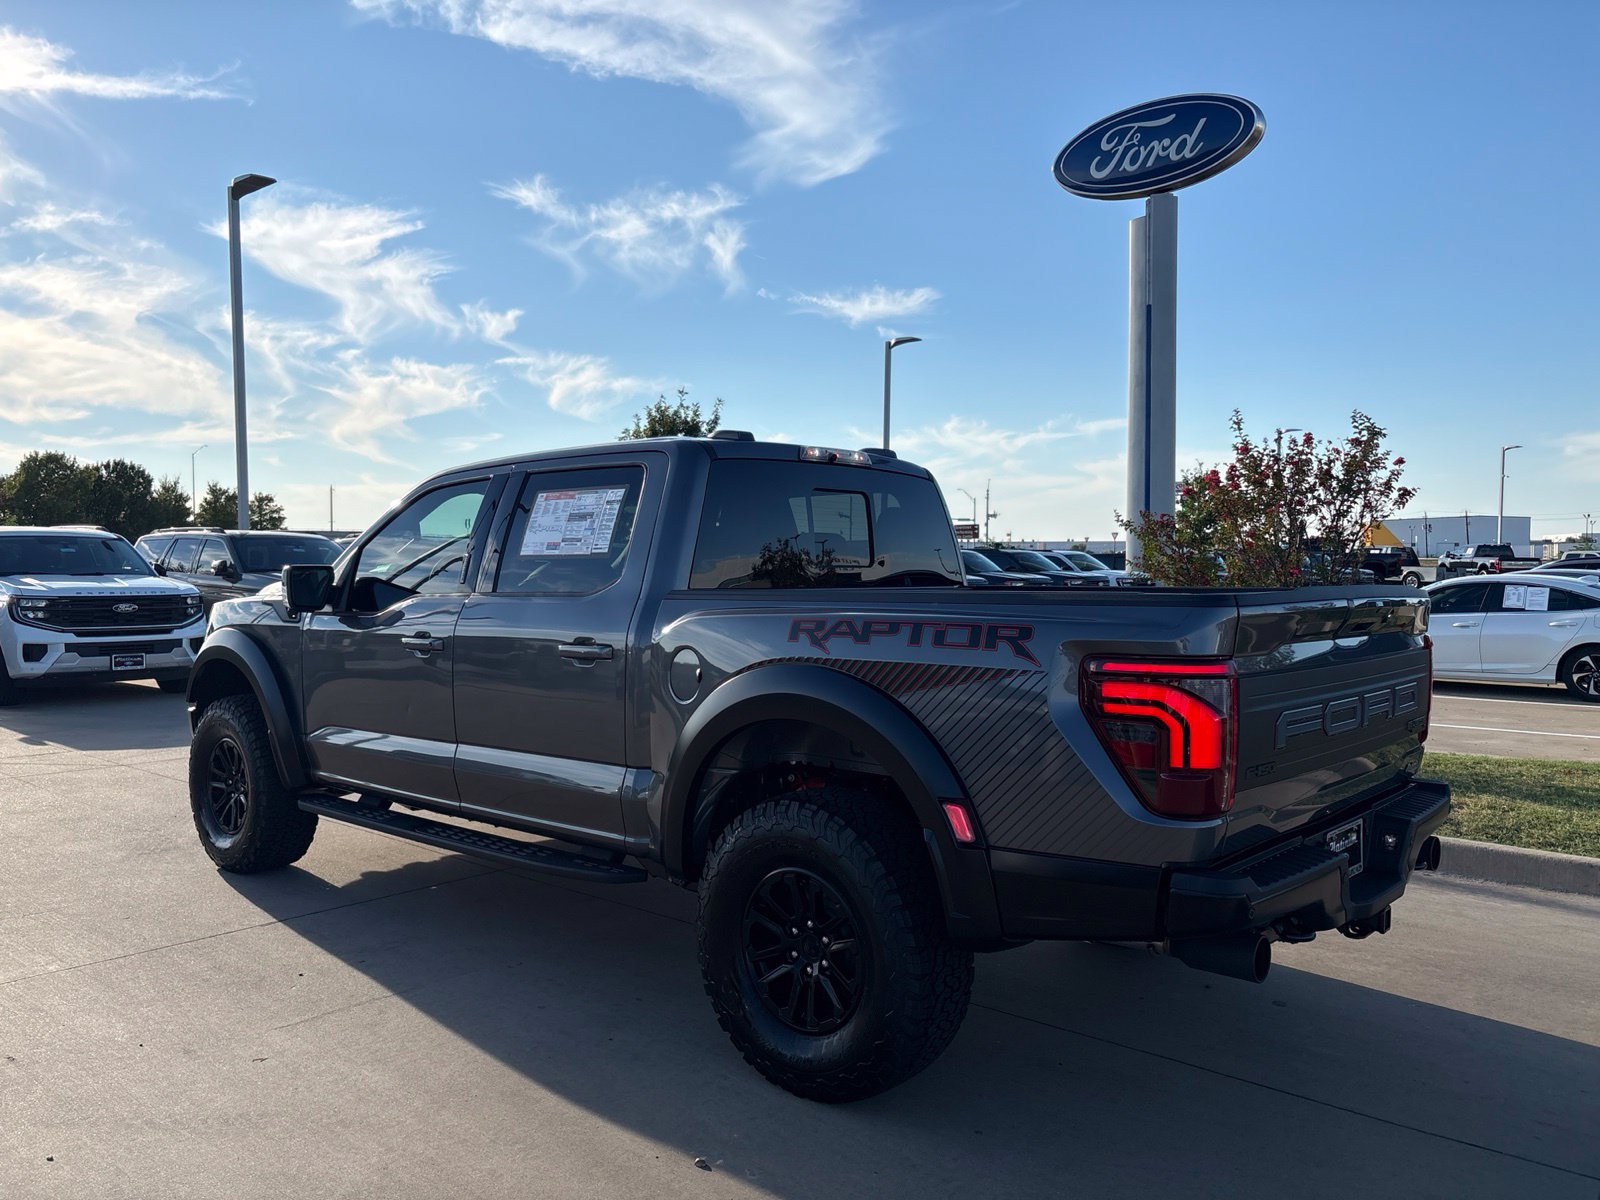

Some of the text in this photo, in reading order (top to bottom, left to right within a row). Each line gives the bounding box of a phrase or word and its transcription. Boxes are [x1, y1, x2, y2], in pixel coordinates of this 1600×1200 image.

[1090, 114, 1207, 179] Ford
[787, 617, 1041, 668] RAPTOR
[1274, 681, 1417, 750] FORD
